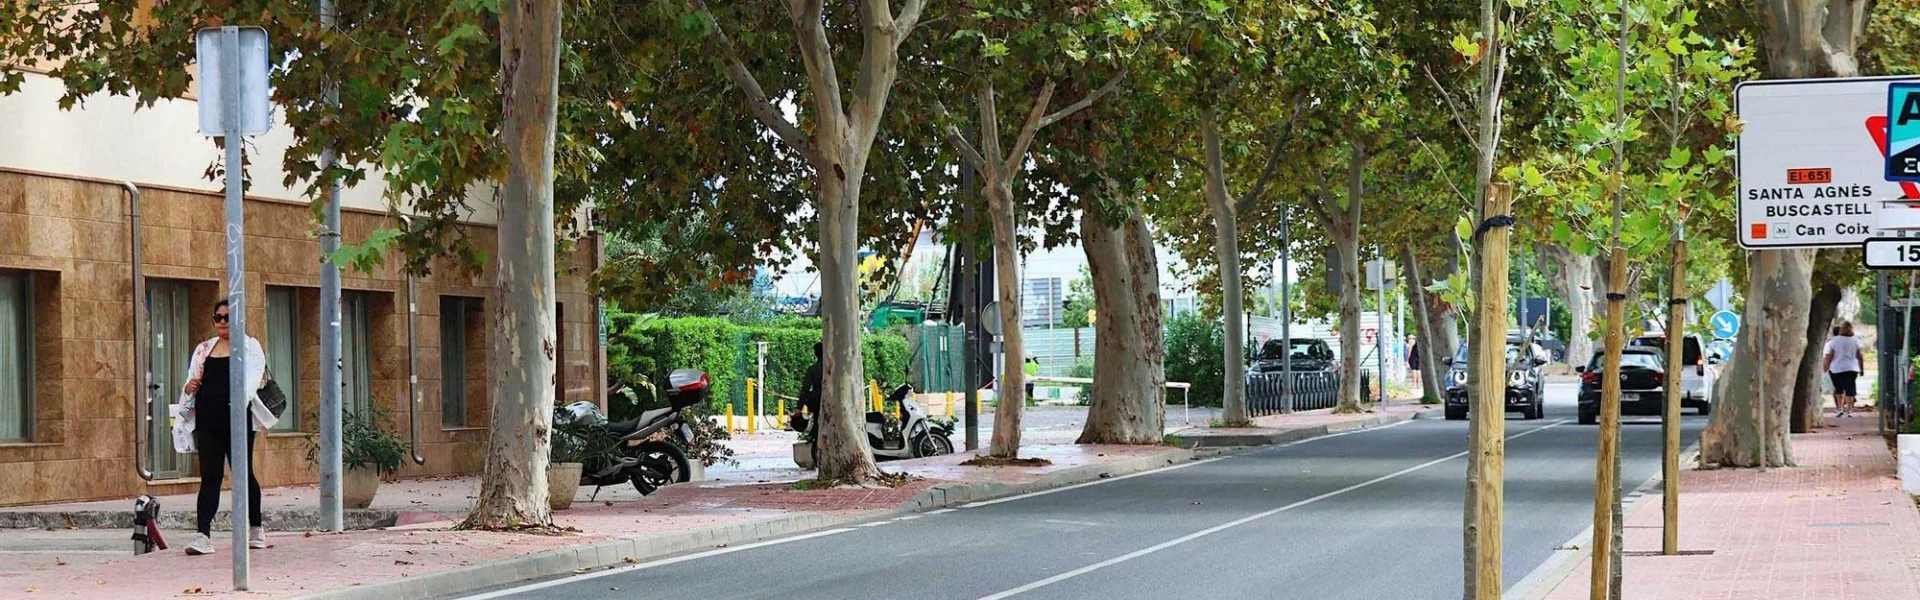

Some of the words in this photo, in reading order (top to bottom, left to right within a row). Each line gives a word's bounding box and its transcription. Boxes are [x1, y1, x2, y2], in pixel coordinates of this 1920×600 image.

[1790, 171, 1829, 181] EI-651
[1748, 188, 1804, 200] SANTA
[1814, 183, 1872, 199] AGNÈS
[1766, 203, 1872, 217] BUSCASTELL
[1796, 224, 1825, 236] Can
[1835, 223, 1870, 235] Coix
